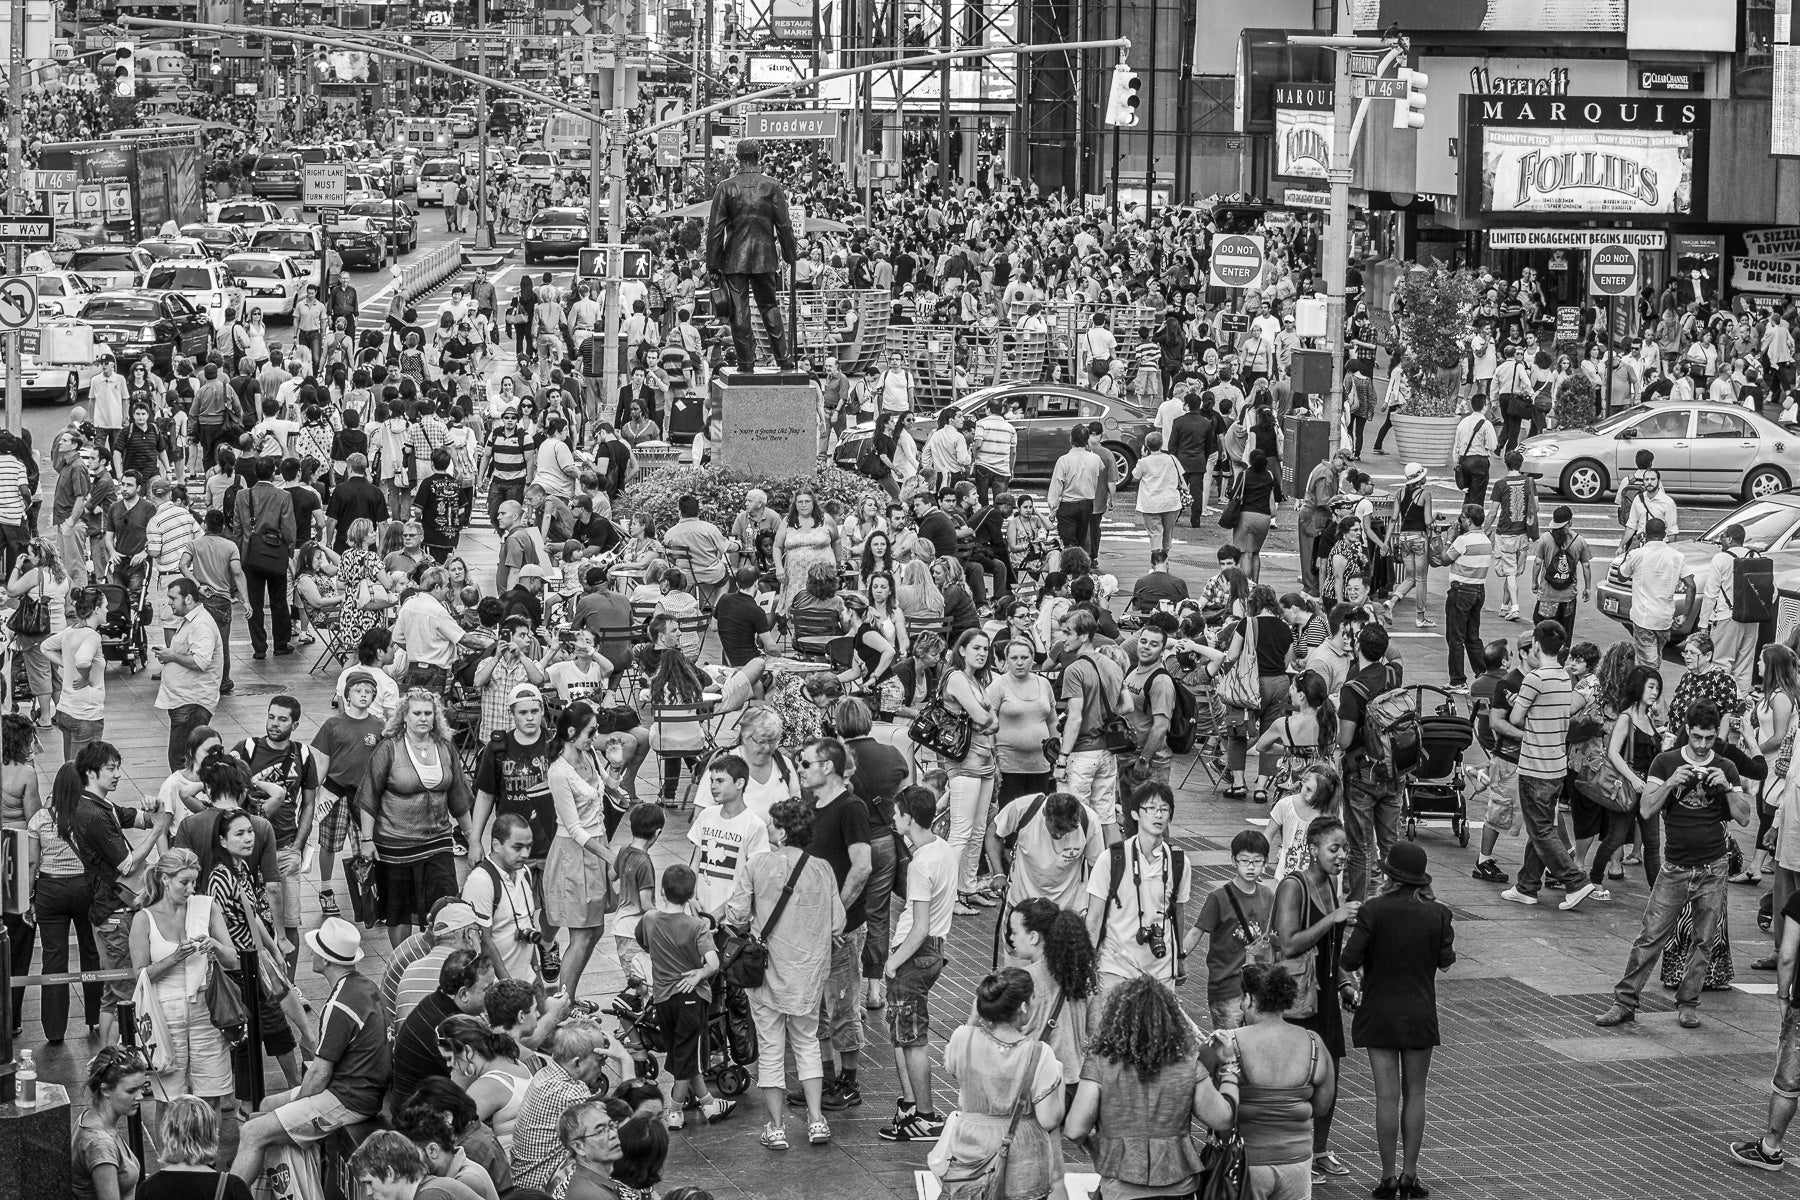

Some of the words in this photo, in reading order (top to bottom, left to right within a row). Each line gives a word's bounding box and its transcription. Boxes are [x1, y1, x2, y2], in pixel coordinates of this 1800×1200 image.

[1352, 56, 1378, 74] BROADWAY
[1470, 67, 1570, 95] Marriott
[1652, 73, 1666, 83] CLEAR
[1666, 73, 1688, 84] CHANNEL
[1368, 82, 1376, 96] W
[1380, 81, 1392, 97] 46
[1396, 81, 1405, 90] ST
[1483, 101, 1696, 123] MARQUIS
[760, 118, 824, 134] Broadway
[1490, 132, 1527, 143] BERNADETTE
[1528, 136, 1549, 145] PETERS
[38, 173, 47, 188] W
[50, 173, 62, 188] 46
[66, 174, 74, 182] ST
[314, 180, 336, 189] MUST
[1513, 149, 1659, 208] FOLLIES
[20, 225, 44, 234] WAY
[1492, 233, 1526, 244] LIMITED
[1529, 233, 1587, 244] ENGAGEMENT
[1590, 234, 1620, 244] BEGINS
[1622, 234, 1656, 246] AUGUST
[1658, 234, 1663, 246] 7
[1222, 244, 1234, 254] DO
[1236, 246, 1254, 255] NOT
[1600, 254, 1610, 262] DO
[1614, 254, 1629, 263] NOT
[1222, 268, 1250, 277] ENTER
[1748, 270, 1762, 282] BE
[1600, 276, 1626, 286] ENTER
[82, 973, 96, 982] tkts
